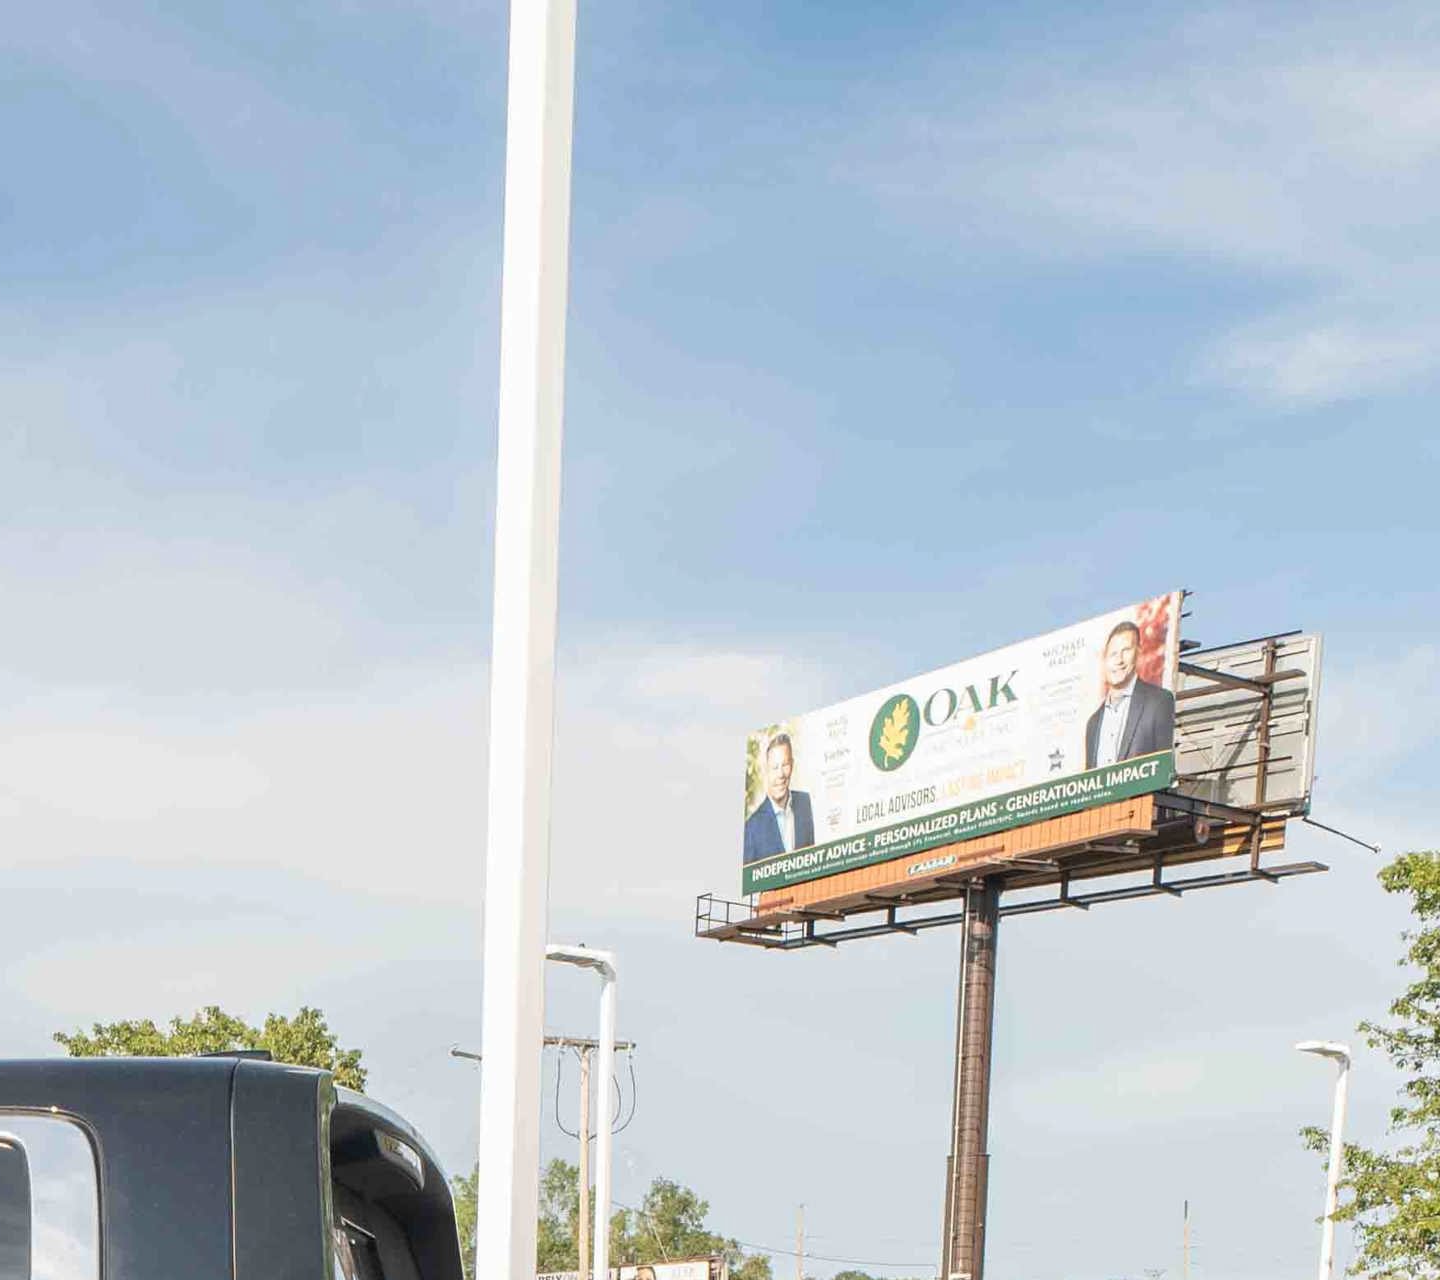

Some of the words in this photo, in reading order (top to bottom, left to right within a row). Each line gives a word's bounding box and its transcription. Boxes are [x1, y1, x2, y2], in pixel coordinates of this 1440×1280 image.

[923, 669, 1019, 727] OAK
[751, 848, 827, 882] INDEPENDENT
[826, 837, 866, 862] ADVICE
[874, 812, 957, 848] PERSONALIZED
[959, 801, 998, 825] PLANS
[1005, 775, 1104, 812] GENERATIONAL
[1105, 760, 1160, 787] IMPACT
[856, 805, 886, 825] LOCAL
[888, 785, 936, 819] ADVISORS
